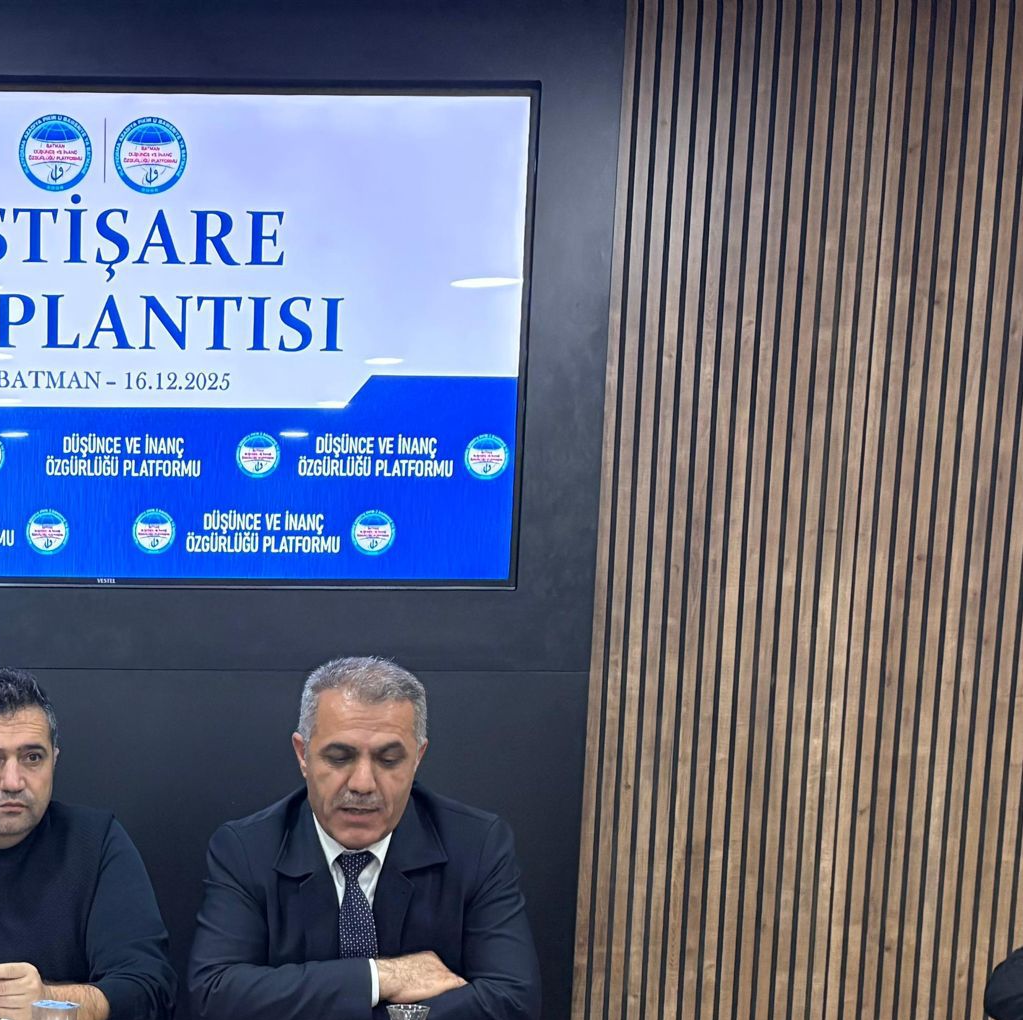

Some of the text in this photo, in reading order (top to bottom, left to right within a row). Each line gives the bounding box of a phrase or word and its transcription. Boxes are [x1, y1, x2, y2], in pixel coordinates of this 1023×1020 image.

[126, 372, 231, 391] 16.12.2025
[62, 433, 185, 459] DÜŞÜNCE VE İNANÇ
[315, 433, 375, 458] DÜŞÜNCE
[377, 437, 395, 455] VE
[397, 434, 438, 460] İNANÇ
[45, 455, 201, 478] ÖZGÜRLÜĞÜ PLATFORMU
[297, 455, 372, 477] ÖZGÜRLÜĞÜ
[375, 458, 454, 478] PLATFORMU
[203, 510, 262, 534] DÜŞÜNCE
[264, 514, 282, 531] VE
[284, 511, 325, 536] İNANÇ
[185, 531, 259, 553] ÖZGÜRLÜĞÜ
[262, 534, 341, 554] PLATFORMU
